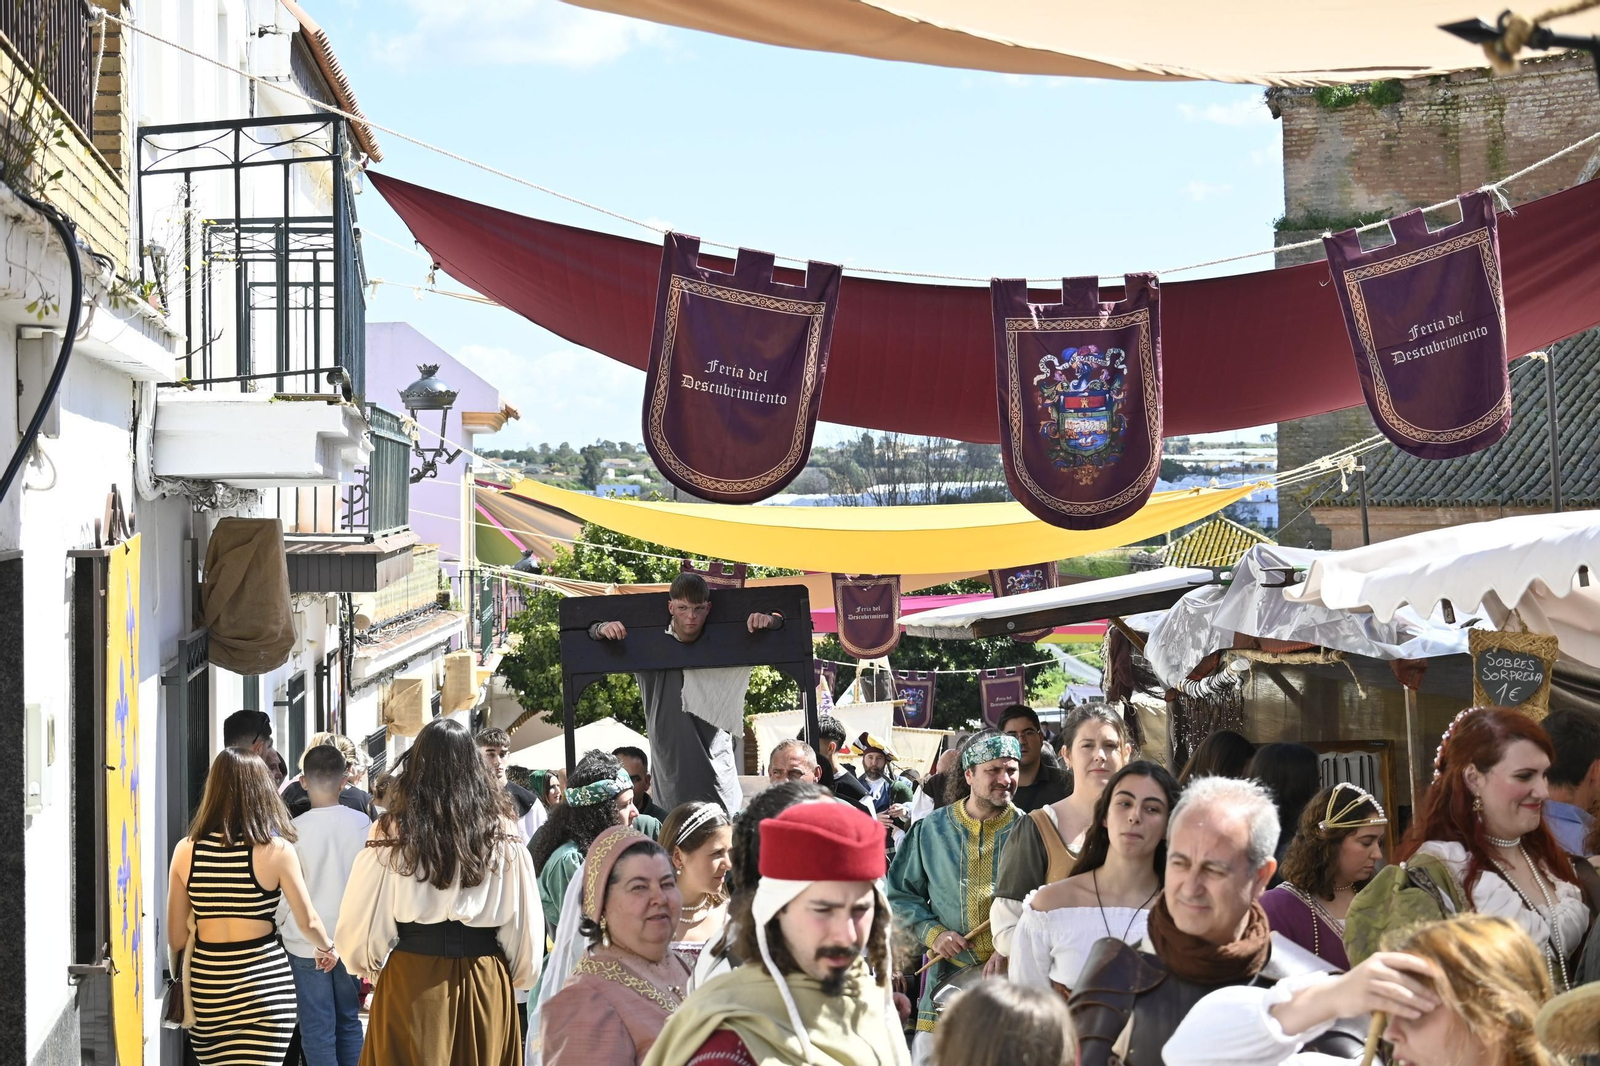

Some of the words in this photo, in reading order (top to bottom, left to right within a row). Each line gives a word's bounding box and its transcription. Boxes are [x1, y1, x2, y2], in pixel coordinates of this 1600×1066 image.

[1408, 320, 1445, 342] Feria
[1447, 311, 1464, 327] del
[1391, 326, 1488, 366] Descubrimiento
[704, 359, 744, 379] Feria
[748, 367, 769, 383] del
[680, 373, 788, 406] Descubrimiento
[1485, 652, 1535, 671] SOBRES
[1482, 667, 1543, 685] SORPRESA
[1495, 682, 1521, 705] 1€
